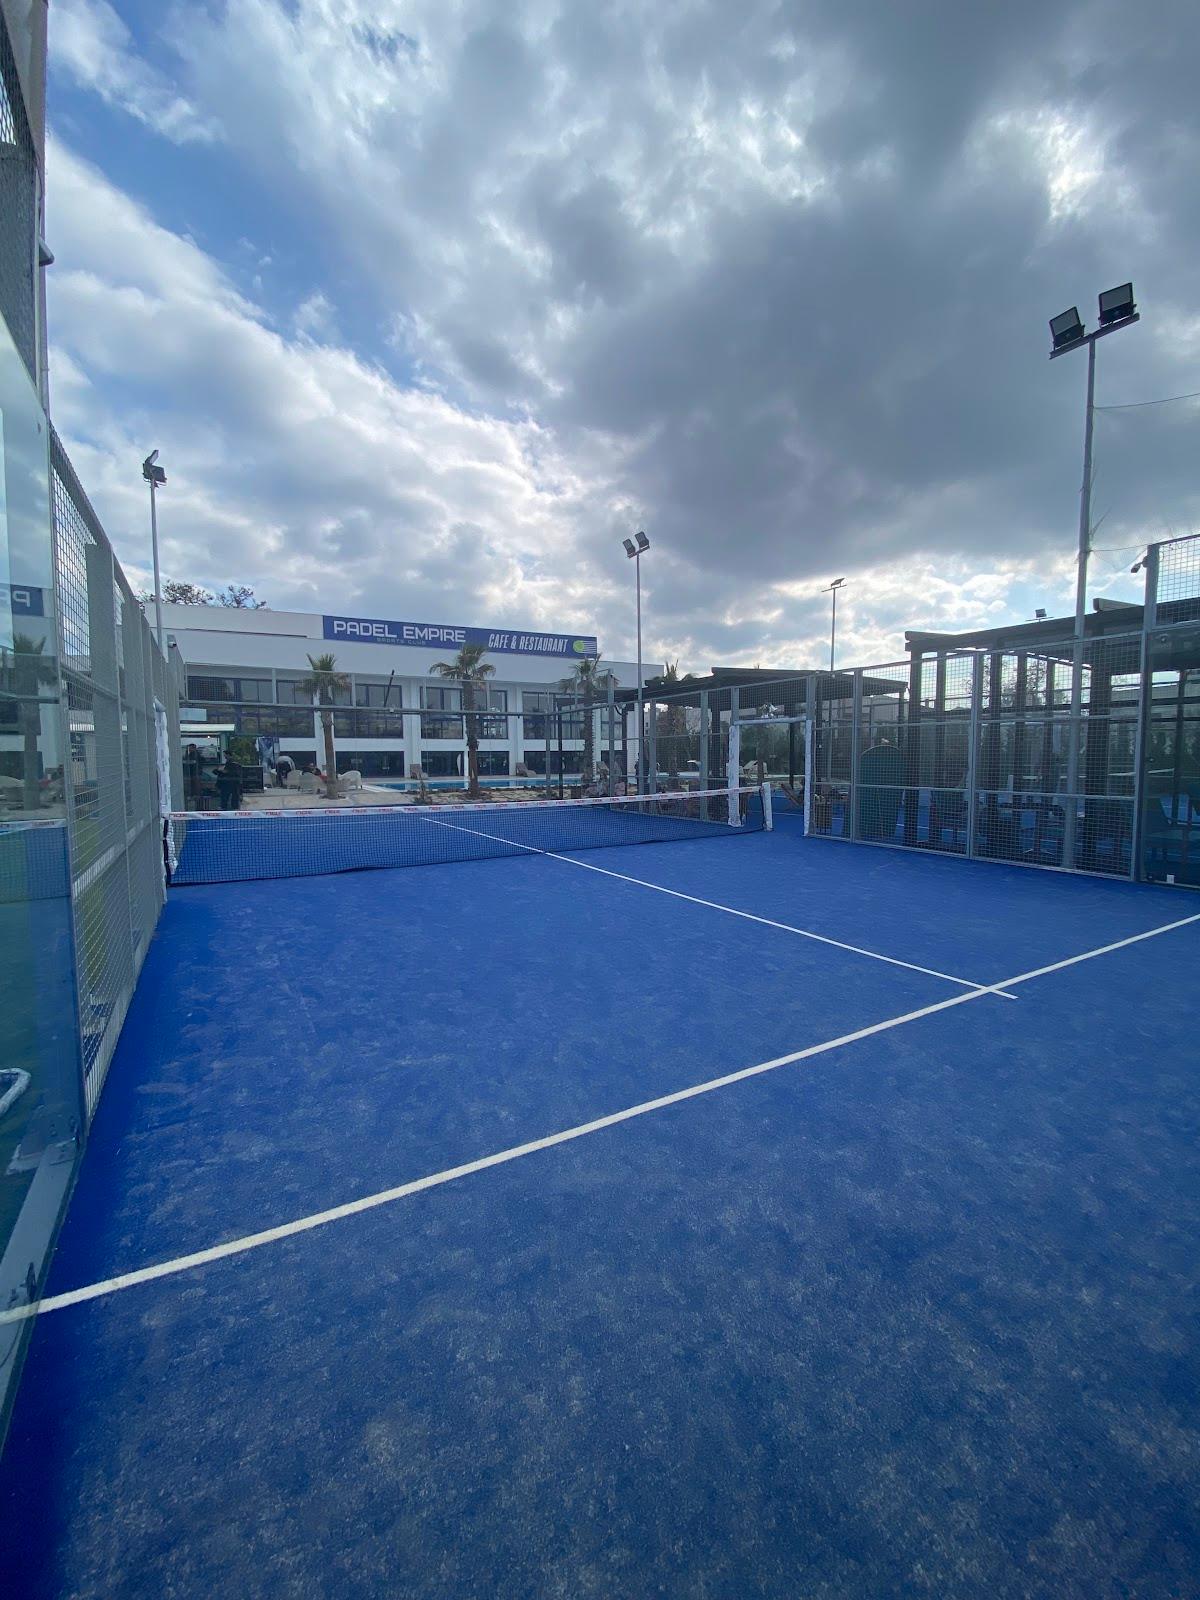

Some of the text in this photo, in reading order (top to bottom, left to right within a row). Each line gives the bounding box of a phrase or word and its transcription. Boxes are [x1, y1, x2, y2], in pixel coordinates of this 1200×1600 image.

[333, 620, 467, 643] PADEL EMPIRE
[488, 633, 569, 653] CAFE & RESTAURANT
